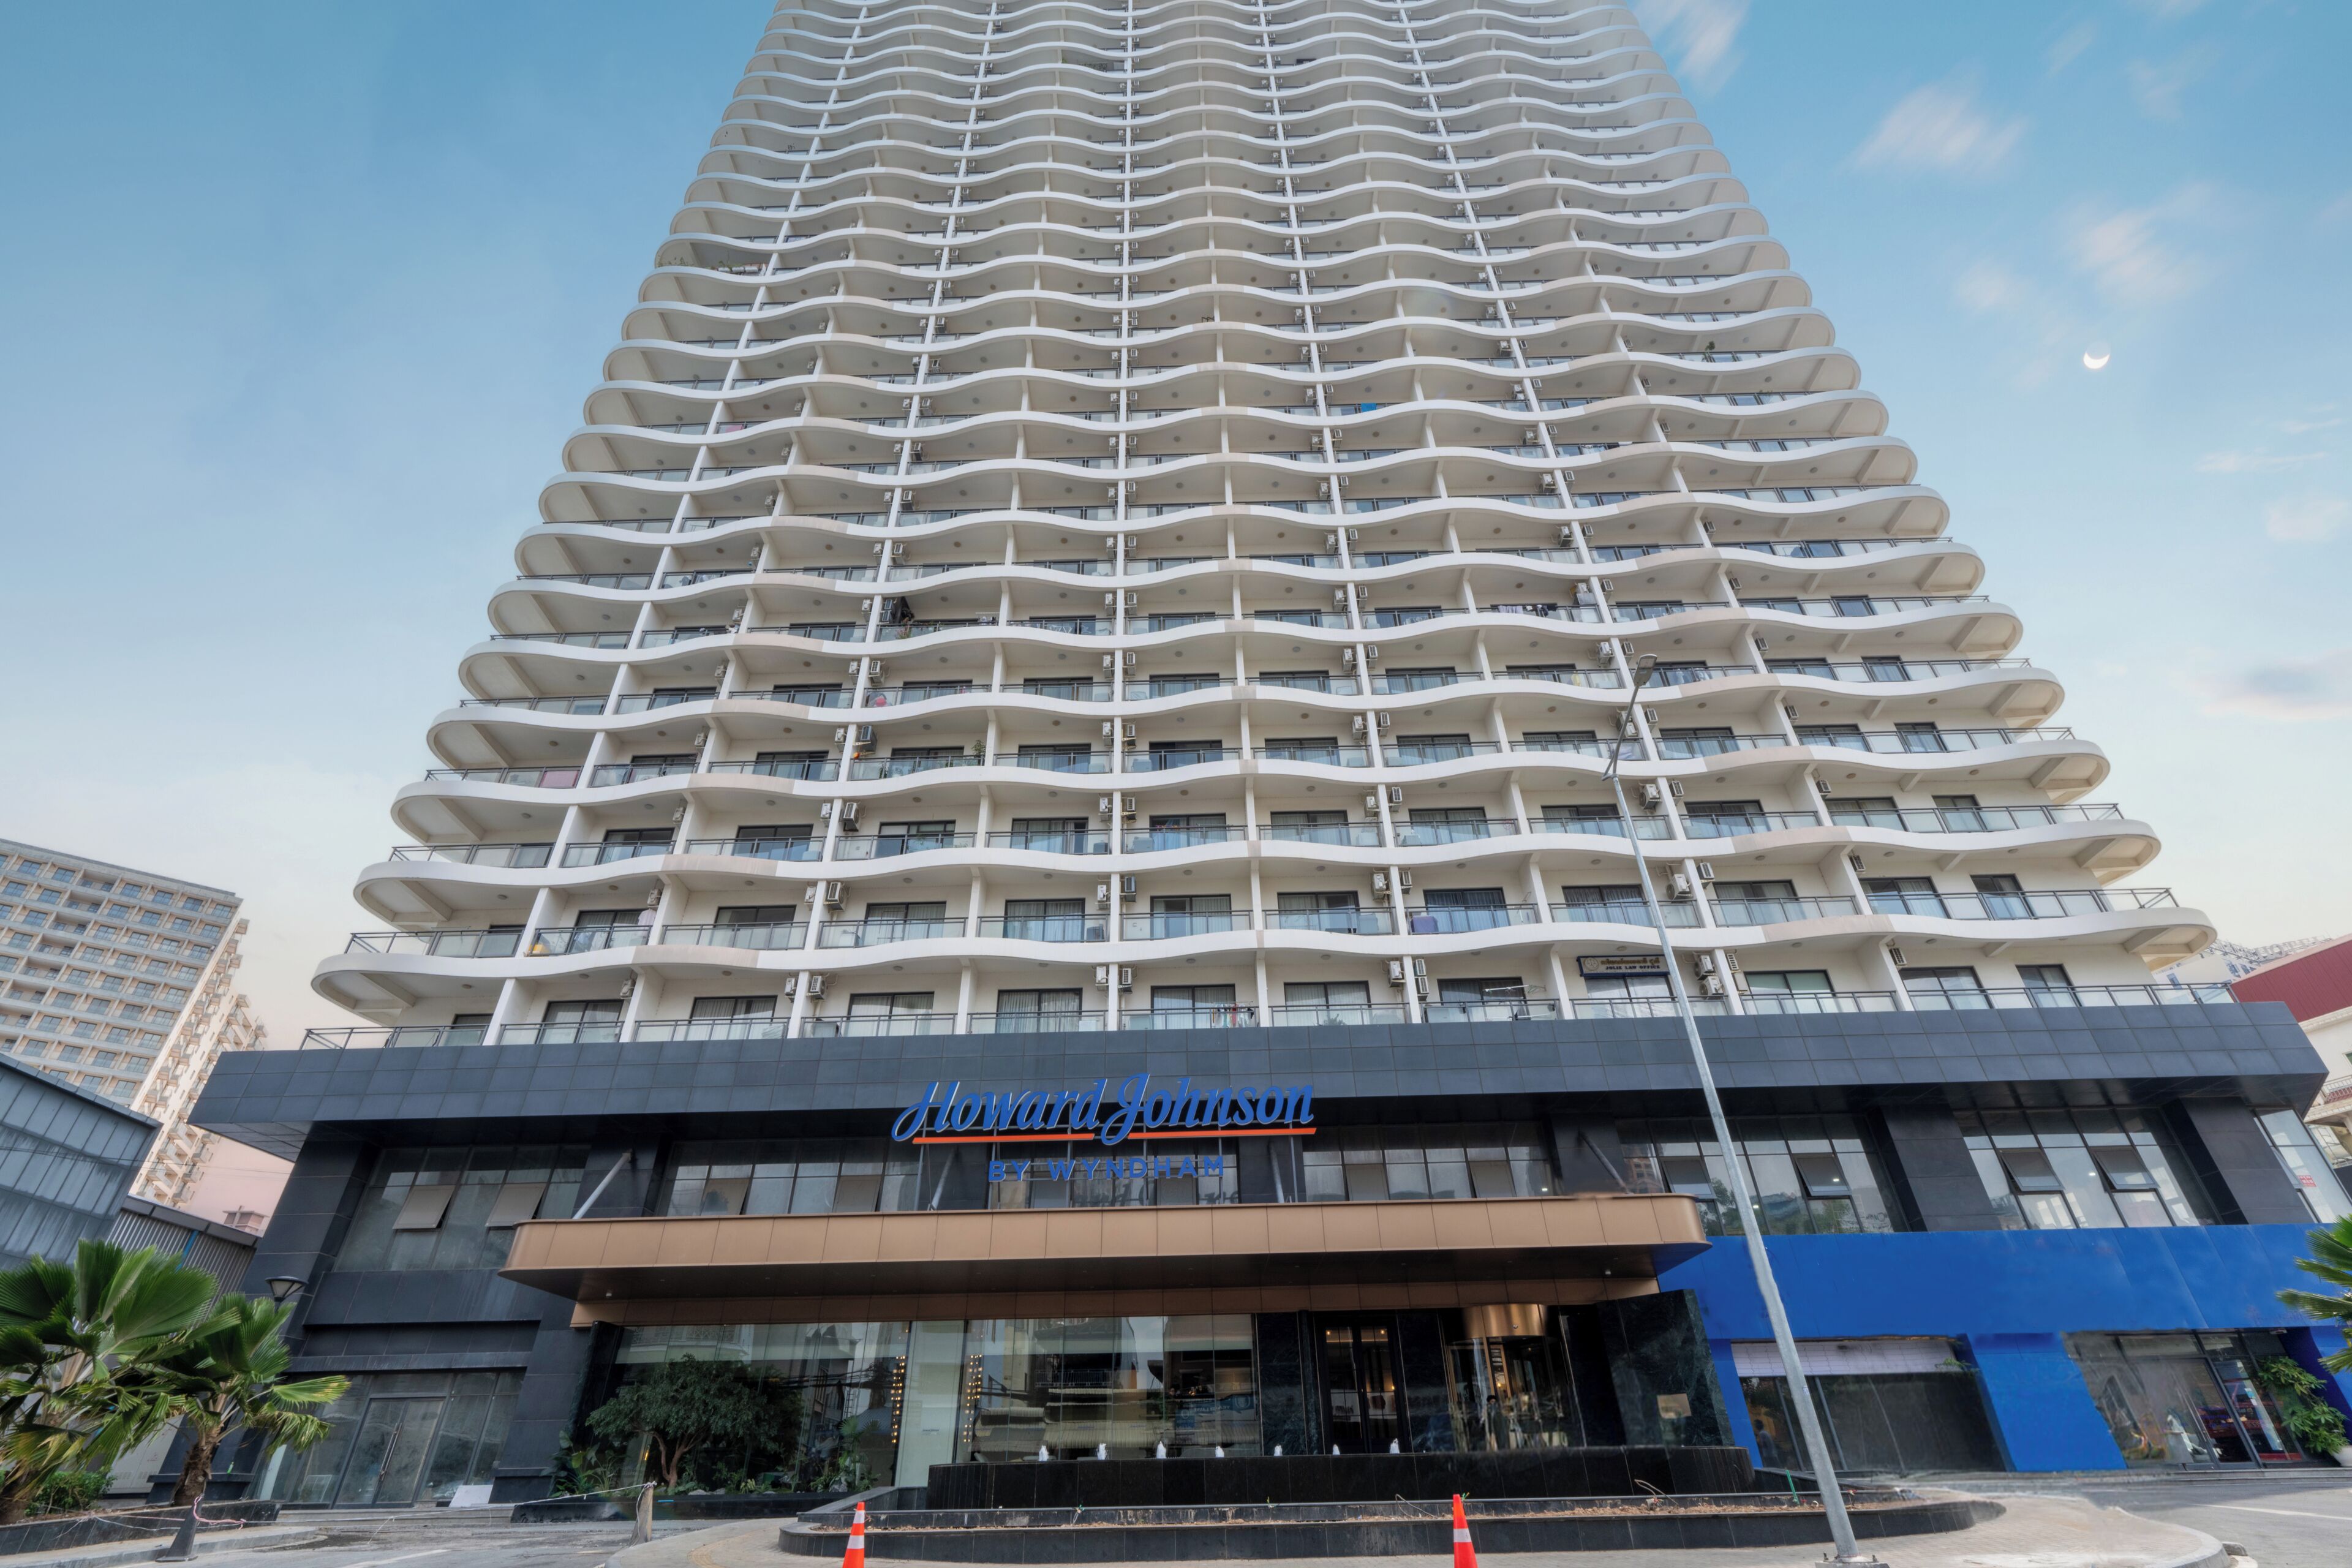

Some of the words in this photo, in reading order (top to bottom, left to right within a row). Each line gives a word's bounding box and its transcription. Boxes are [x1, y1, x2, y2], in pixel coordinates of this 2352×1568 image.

[891, 1079, 1107, 1142] Howard
[1101, 1073, 1314, 1145] Johnson
[989, 1160, 1030, 1182] BY
[1048, 1155, 1224, 1181] WYNDHAM
